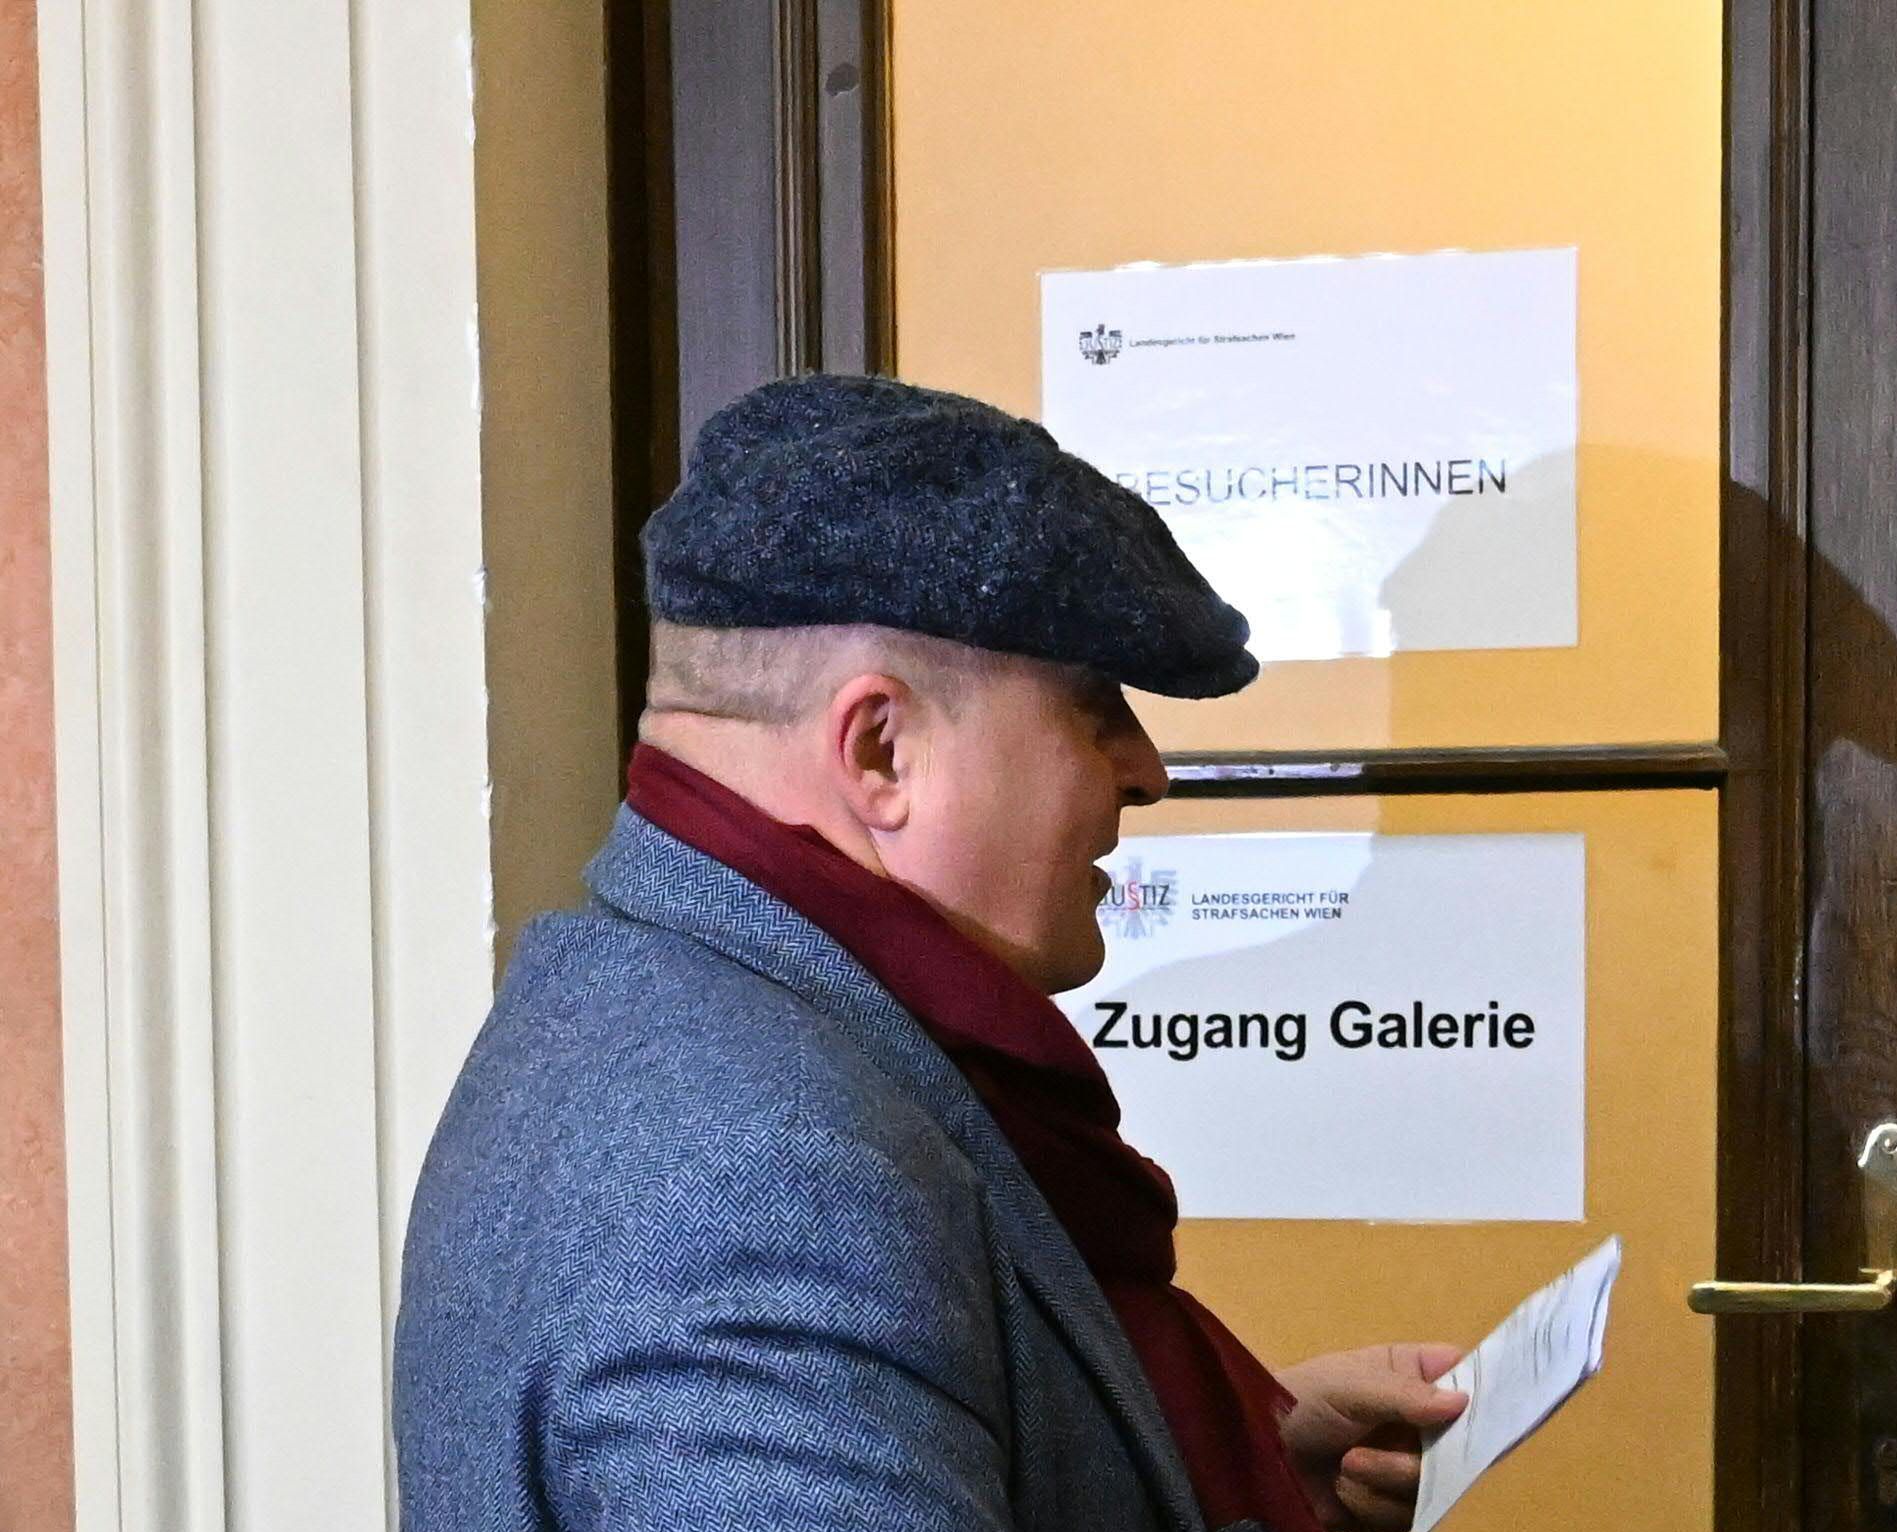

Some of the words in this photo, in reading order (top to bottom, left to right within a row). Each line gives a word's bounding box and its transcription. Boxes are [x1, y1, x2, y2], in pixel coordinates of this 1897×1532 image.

[1191, 893, 1314, 906] LANDESGERICHT
[1319, 891, 1350, 905] FÜR
[1191, 908, 1299, 920] STRAFSACHEN
[1303, 907, 1342, 919] WIEN
[1092, 1001, 1308, 1062] Zugang
[1329, 999, 1536, 1050] Galerie
